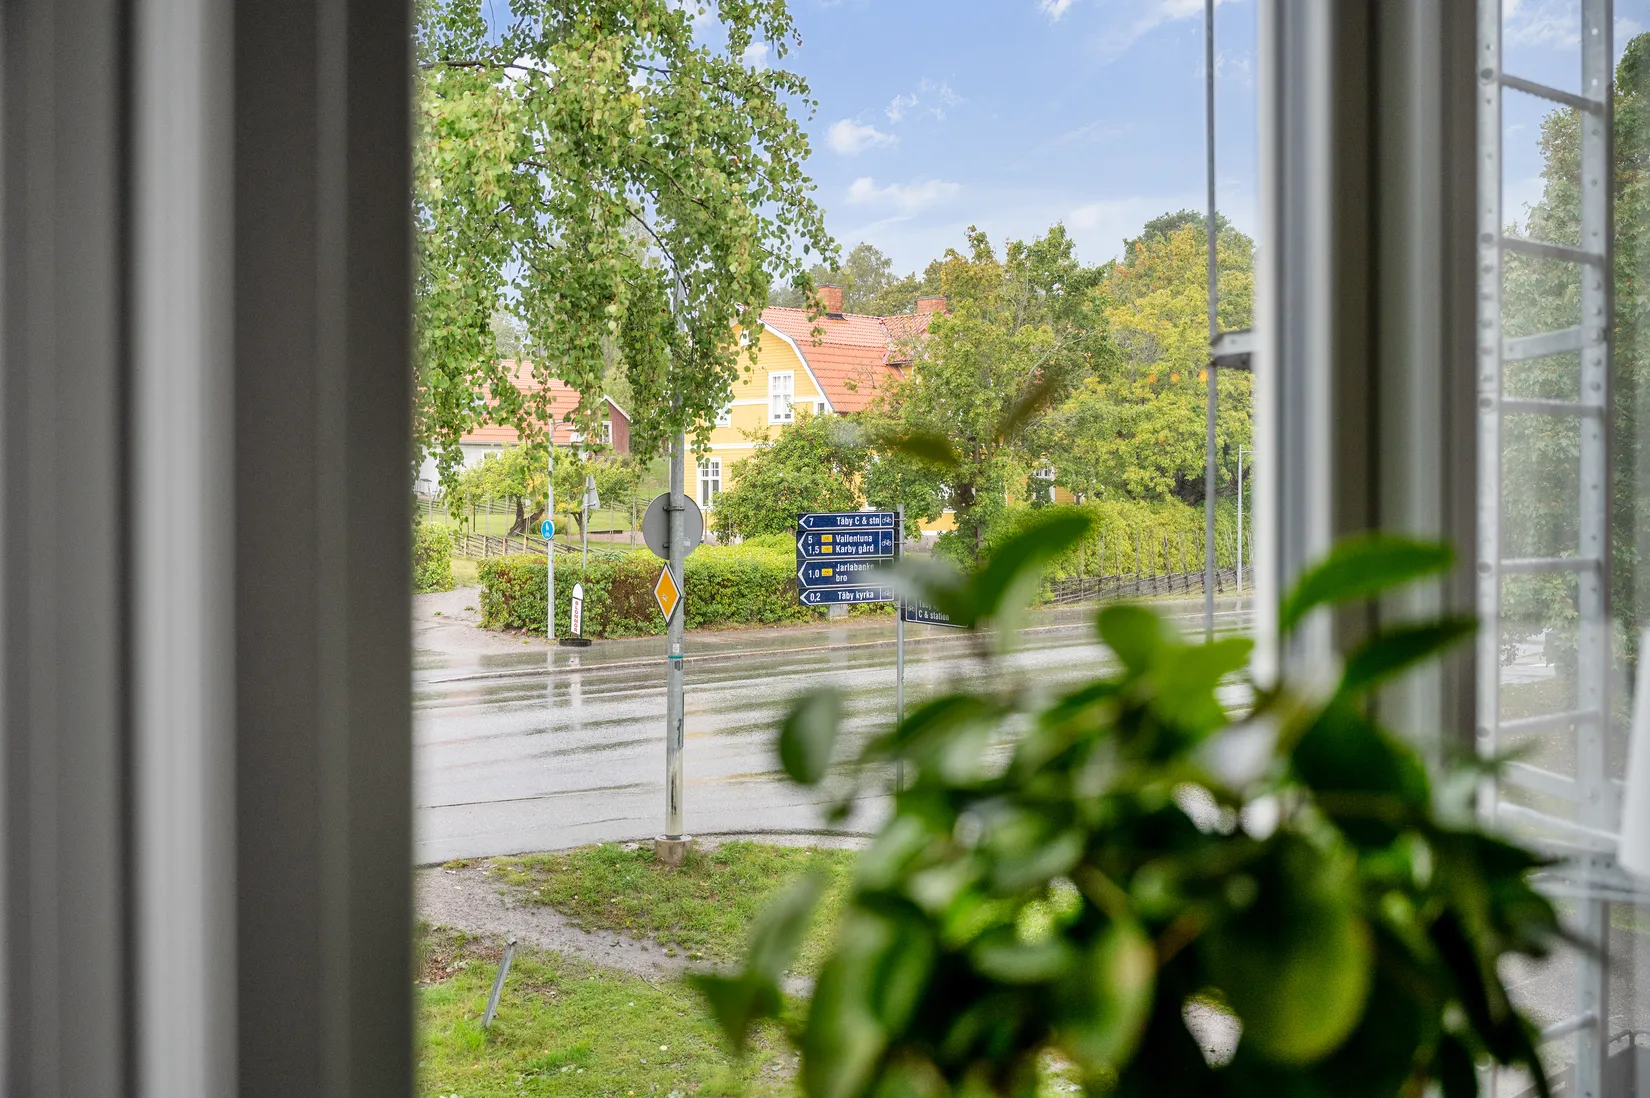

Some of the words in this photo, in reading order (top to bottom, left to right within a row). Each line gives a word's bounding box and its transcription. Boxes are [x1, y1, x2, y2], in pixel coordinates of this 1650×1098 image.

[810, 518, 814, 526] 7
[836, 517, 853, 526] Täby
[854, 516, 860, 525] C
[862, 516, 868, 525] &
[869, 516, 880, 524] stn
[808, 536, 812, 544] 5
[808, 546, 820, 555] 1,5
[836, 545, 856, 554] Karby
[858, 544, 874, 554] gård
[808, 570, 820, 578] 1,0
[810, 593, 820, 602] 0,2
[838, 591, 854, 600] Täby
[856, 591, 874, 600] kyrka
[918, 610, 922, 618] C
[924, 610, 929, 618] &
[930, 611, 950, 621] station
